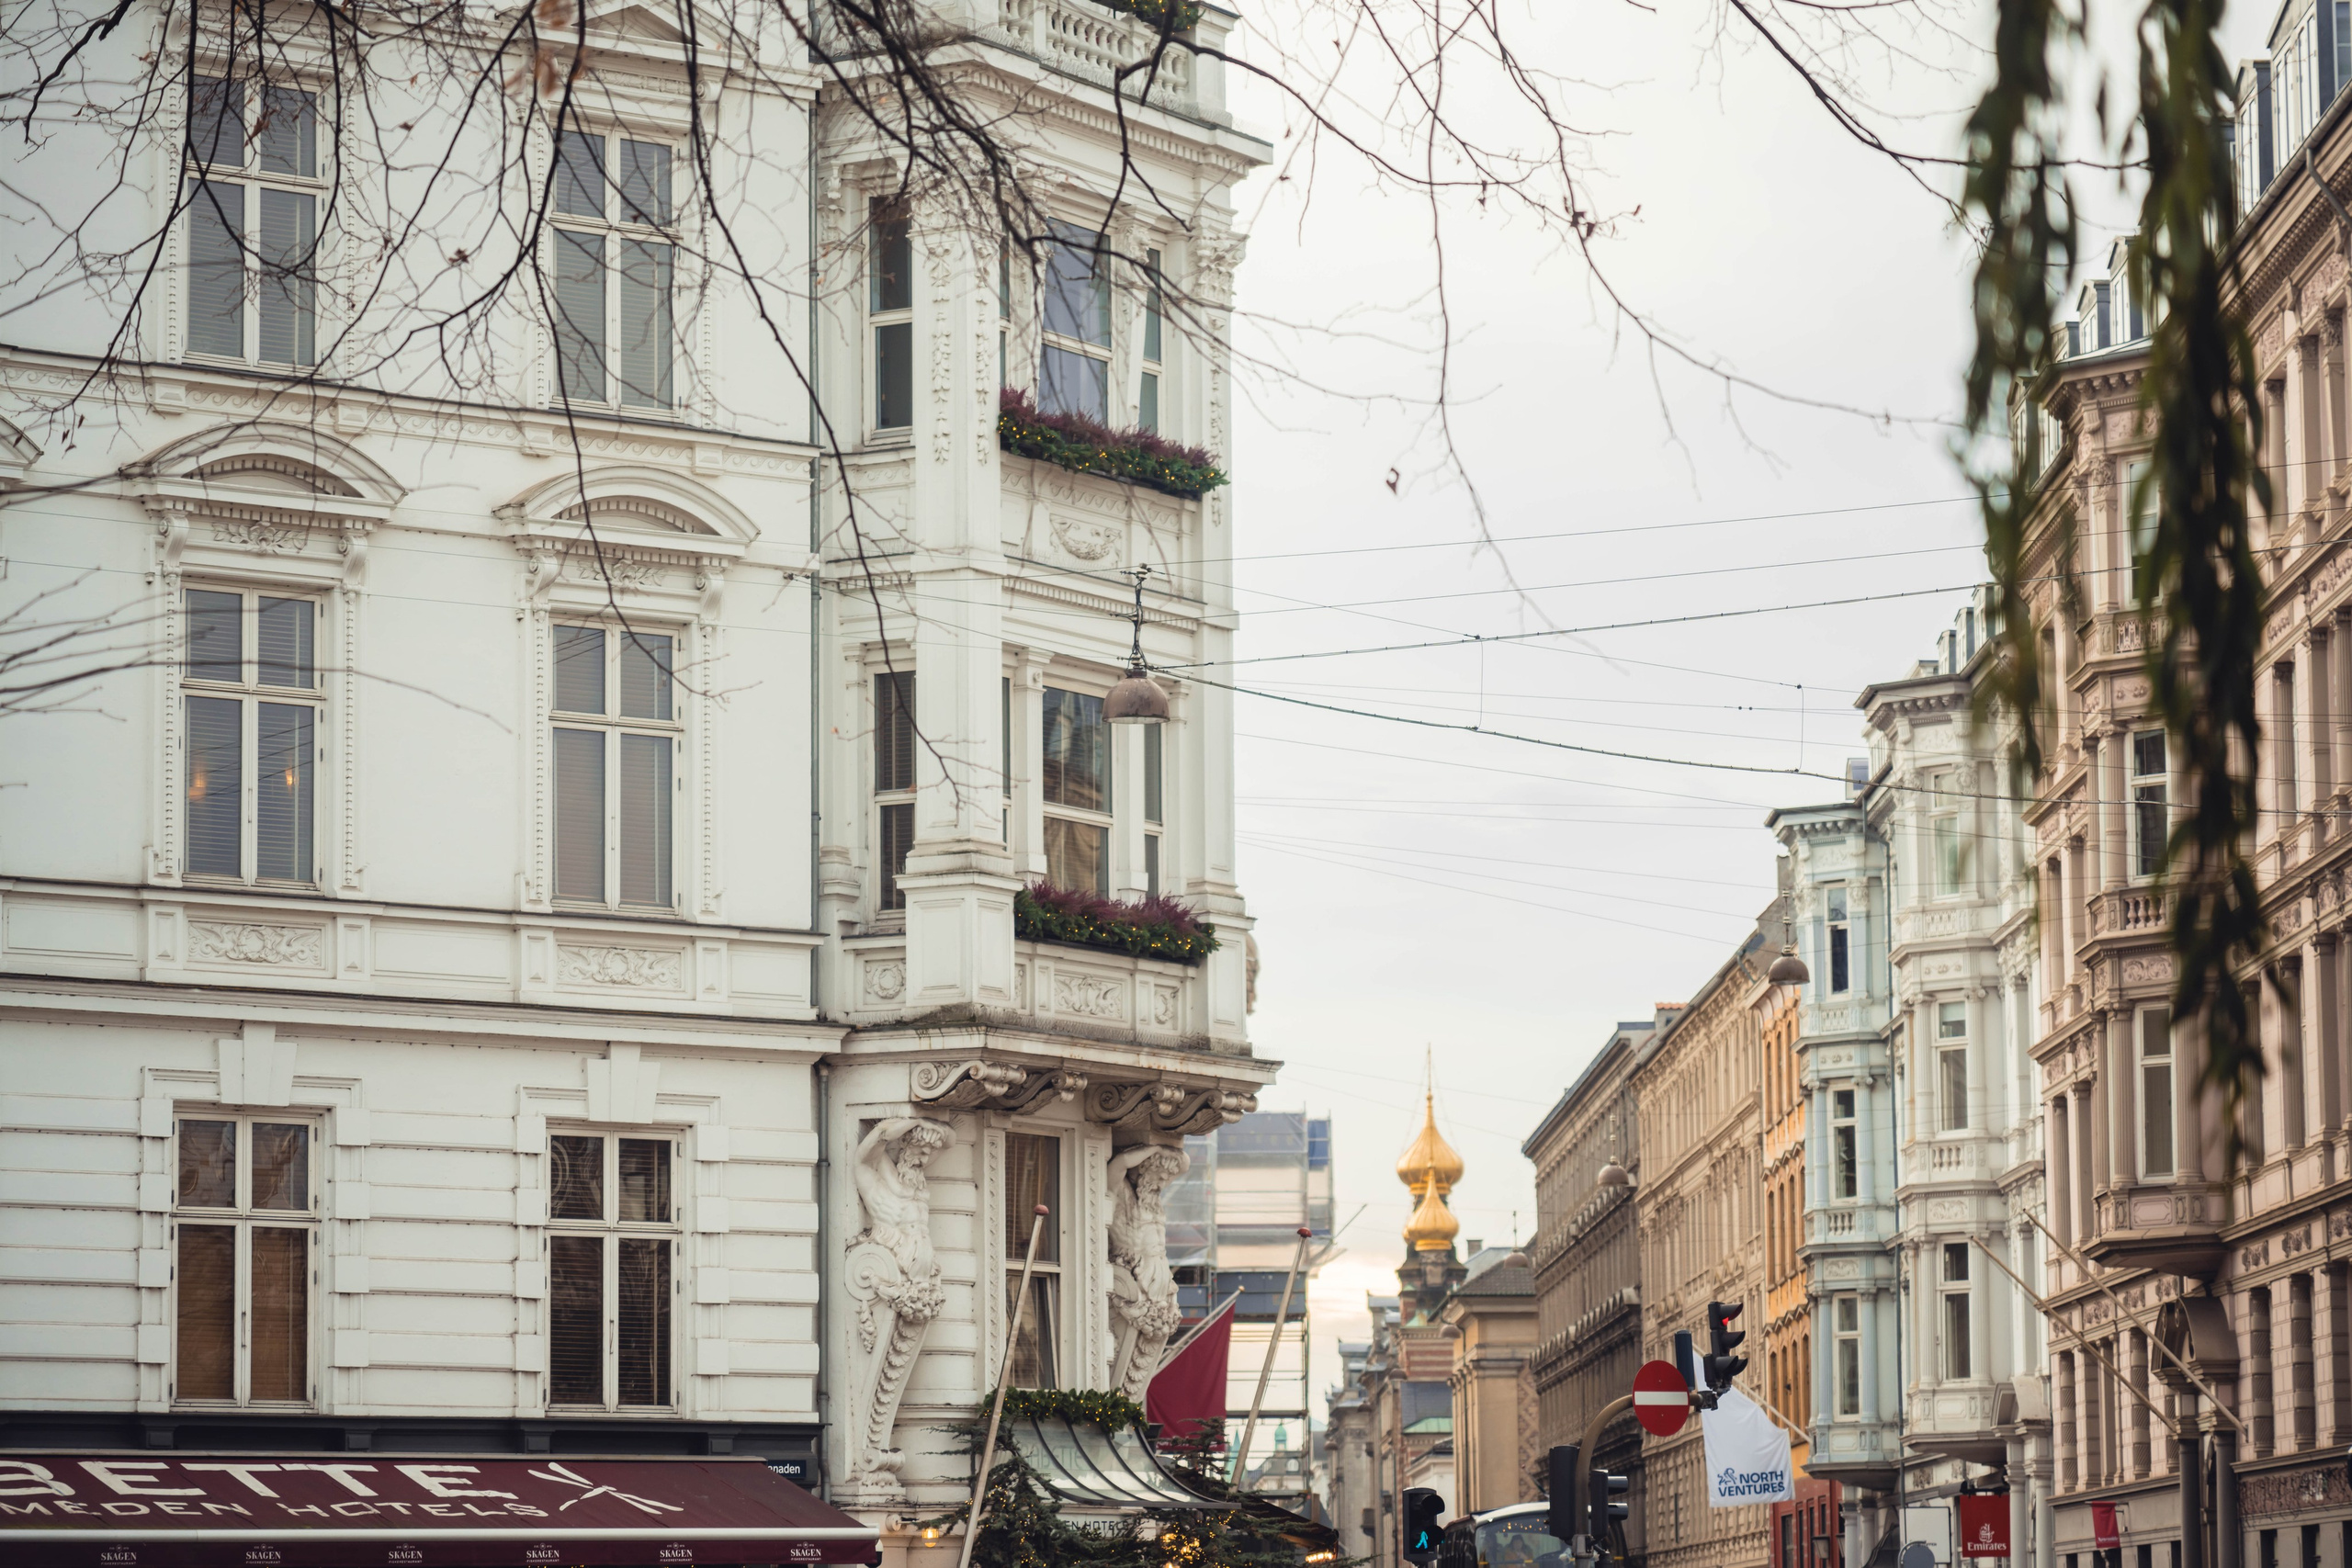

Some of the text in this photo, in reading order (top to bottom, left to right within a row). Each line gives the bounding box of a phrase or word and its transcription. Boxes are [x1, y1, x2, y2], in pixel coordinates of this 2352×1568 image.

[1739, 1470, 1784, 1484] NORTH
[1718, 1481, 1785, 1497] VENTURES
[0, 1500, 548, 1517] MEDEN HOTELS
[1967, 1542, 2007, 1551] Emirates
[101, 1552, 137, 1561] SKAGEN
[245, 1551, 281, 1560] SKAGEN
[389, 1551, 423, 1559] SKAGEN
[526, 1550, 560, 1559] SKAGEN
[660, 1549, 693, 1558] SKAGEN
[790, 1548, 821, 1557] SKAGEN
